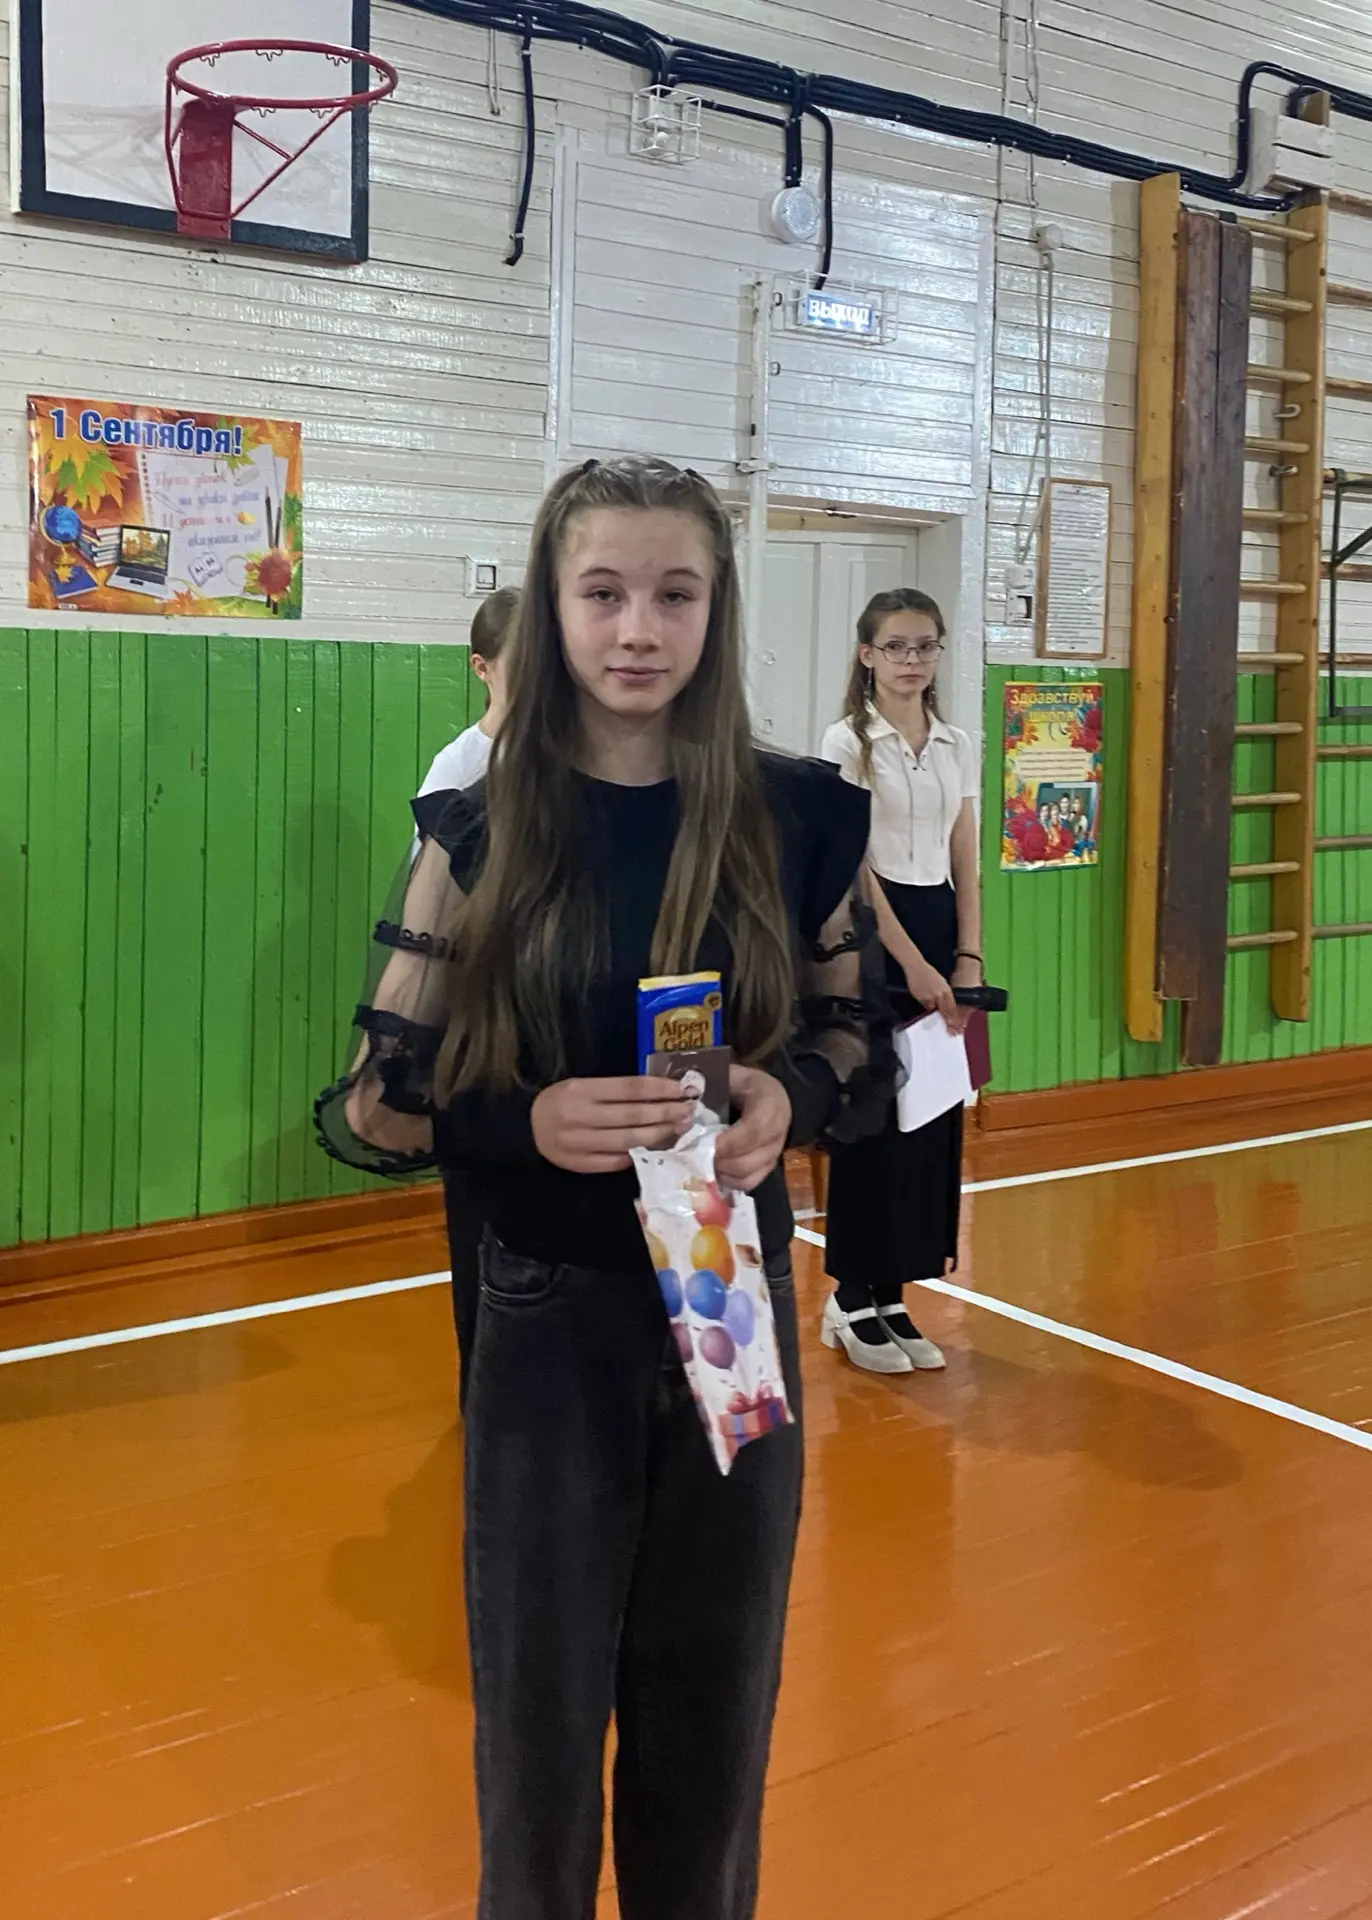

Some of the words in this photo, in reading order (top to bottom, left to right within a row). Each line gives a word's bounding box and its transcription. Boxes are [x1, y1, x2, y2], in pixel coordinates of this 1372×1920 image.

[808, 300, 870, 325] ВЫХОД
[50, 409, 67, 439] 1
[80, 410, 243, 455] Сентября!
[660, 1019, 710, 1037] Alpen
[664, 1033, 705, 1052] Gold
